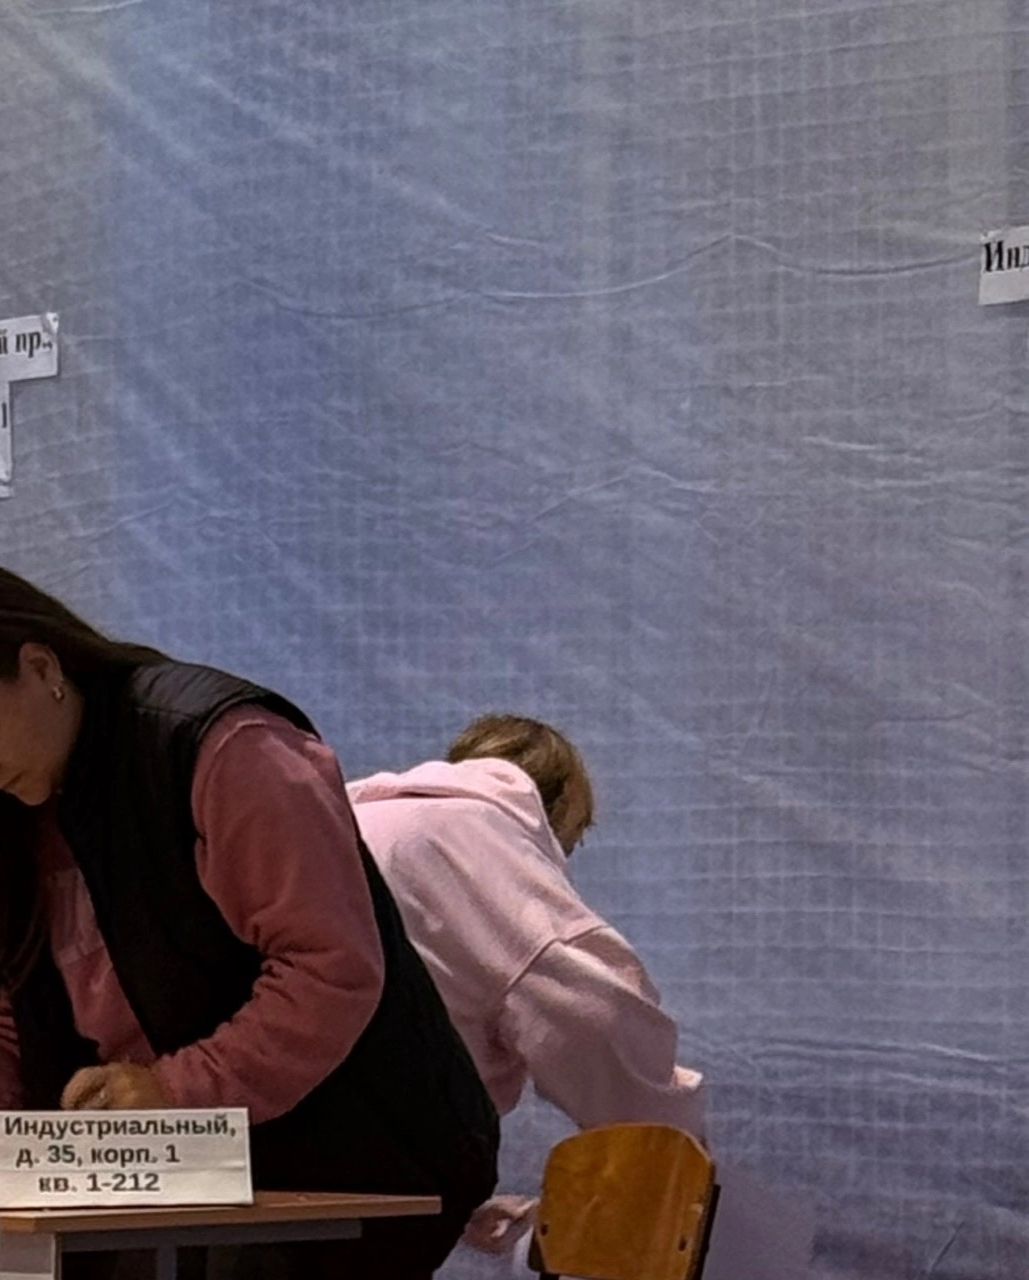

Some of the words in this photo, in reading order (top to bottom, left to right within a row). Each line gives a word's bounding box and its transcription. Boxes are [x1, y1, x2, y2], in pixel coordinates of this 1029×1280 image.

[4, 1114, 236, 1140] Индустриальный,
[15, 1146, 40, 1167] д.
[47, 1145, 83, 1167] 35,
[91, 1147, 158, 1168] корп.
[166, 1145, 180, 1163] 1
[38, 1174, 77, 1193] кв.
[86, 1173, 160, 1192] 1-212
